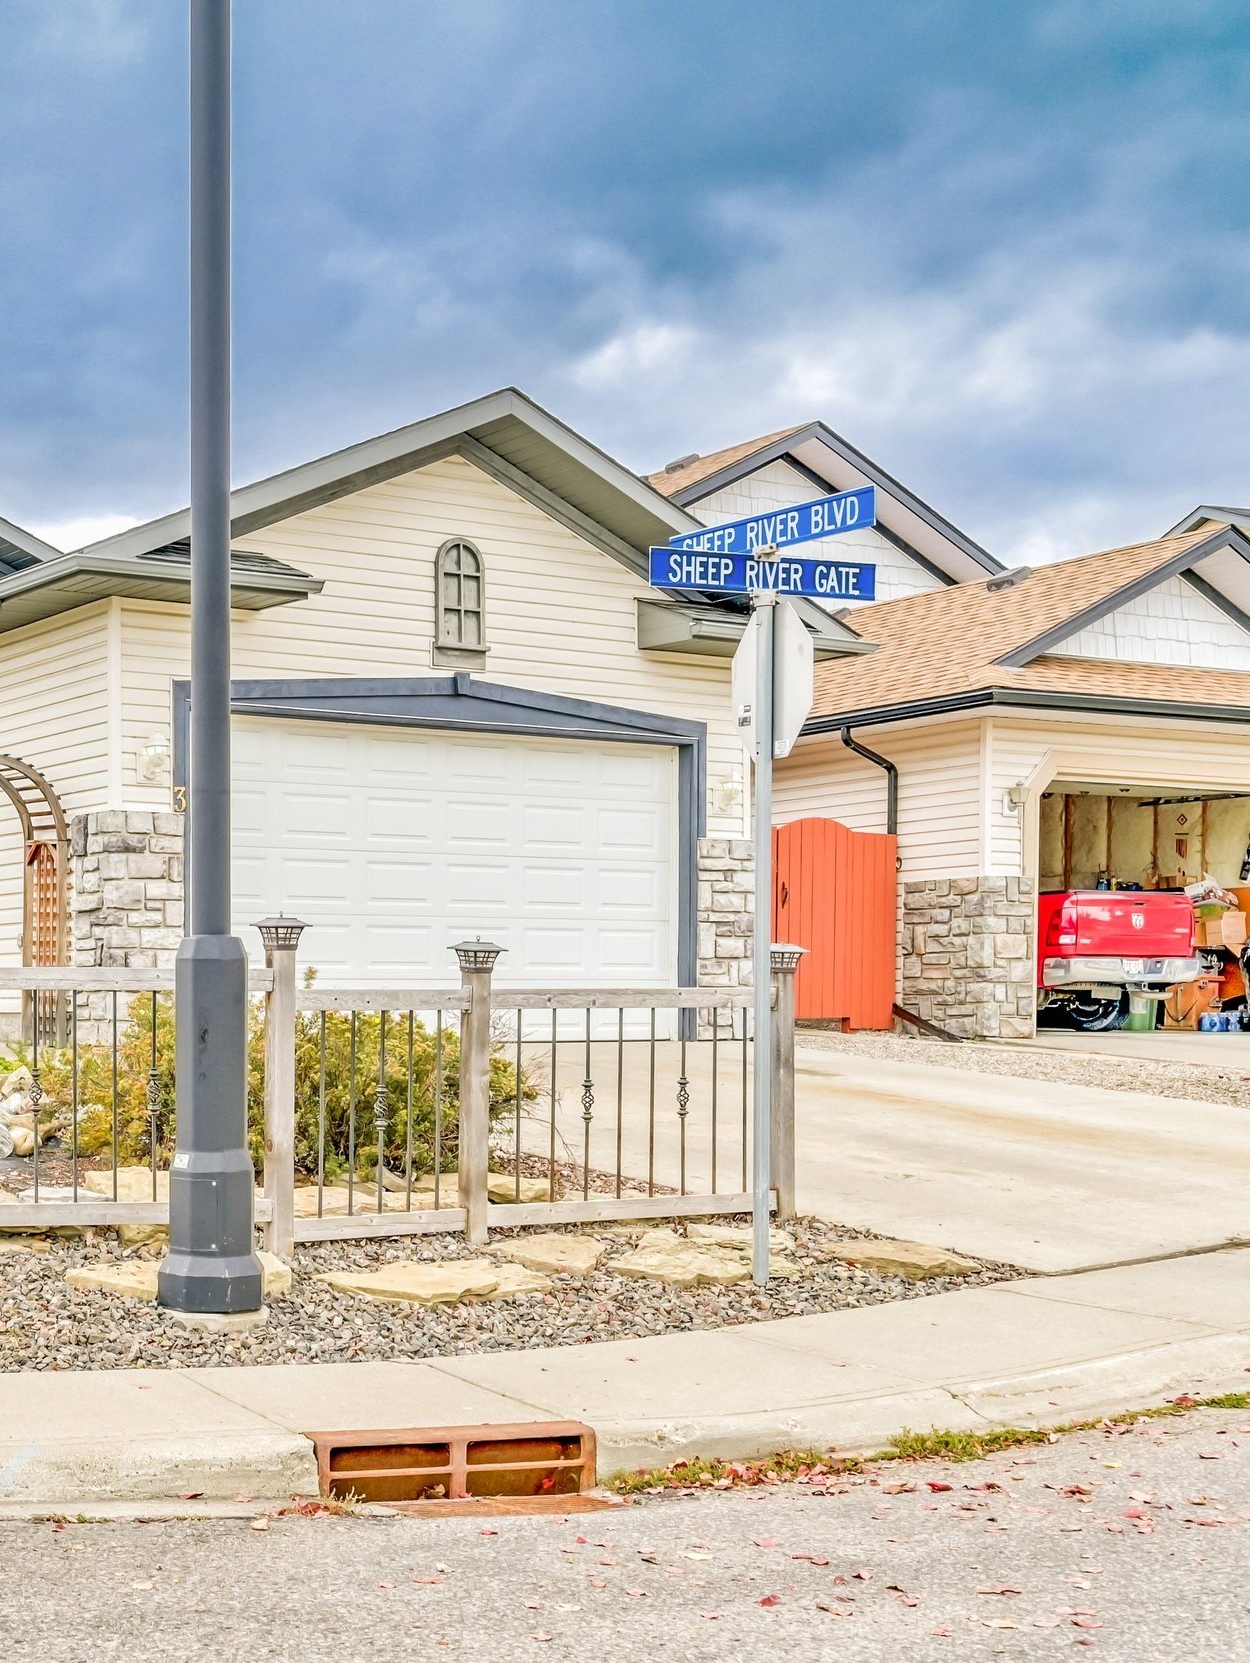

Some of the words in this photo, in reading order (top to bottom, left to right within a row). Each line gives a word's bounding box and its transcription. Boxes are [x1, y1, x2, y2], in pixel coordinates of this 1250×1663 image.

[746, 511, 800, 550] RIVER
[810, 496, 860, 535] BLVD
[668, 554, 734, 586] SHEEP
[745, 560, 803, 592] RIVER
[814, 565, 861, 595] GATE
[173, 786, 187, 812] 3
